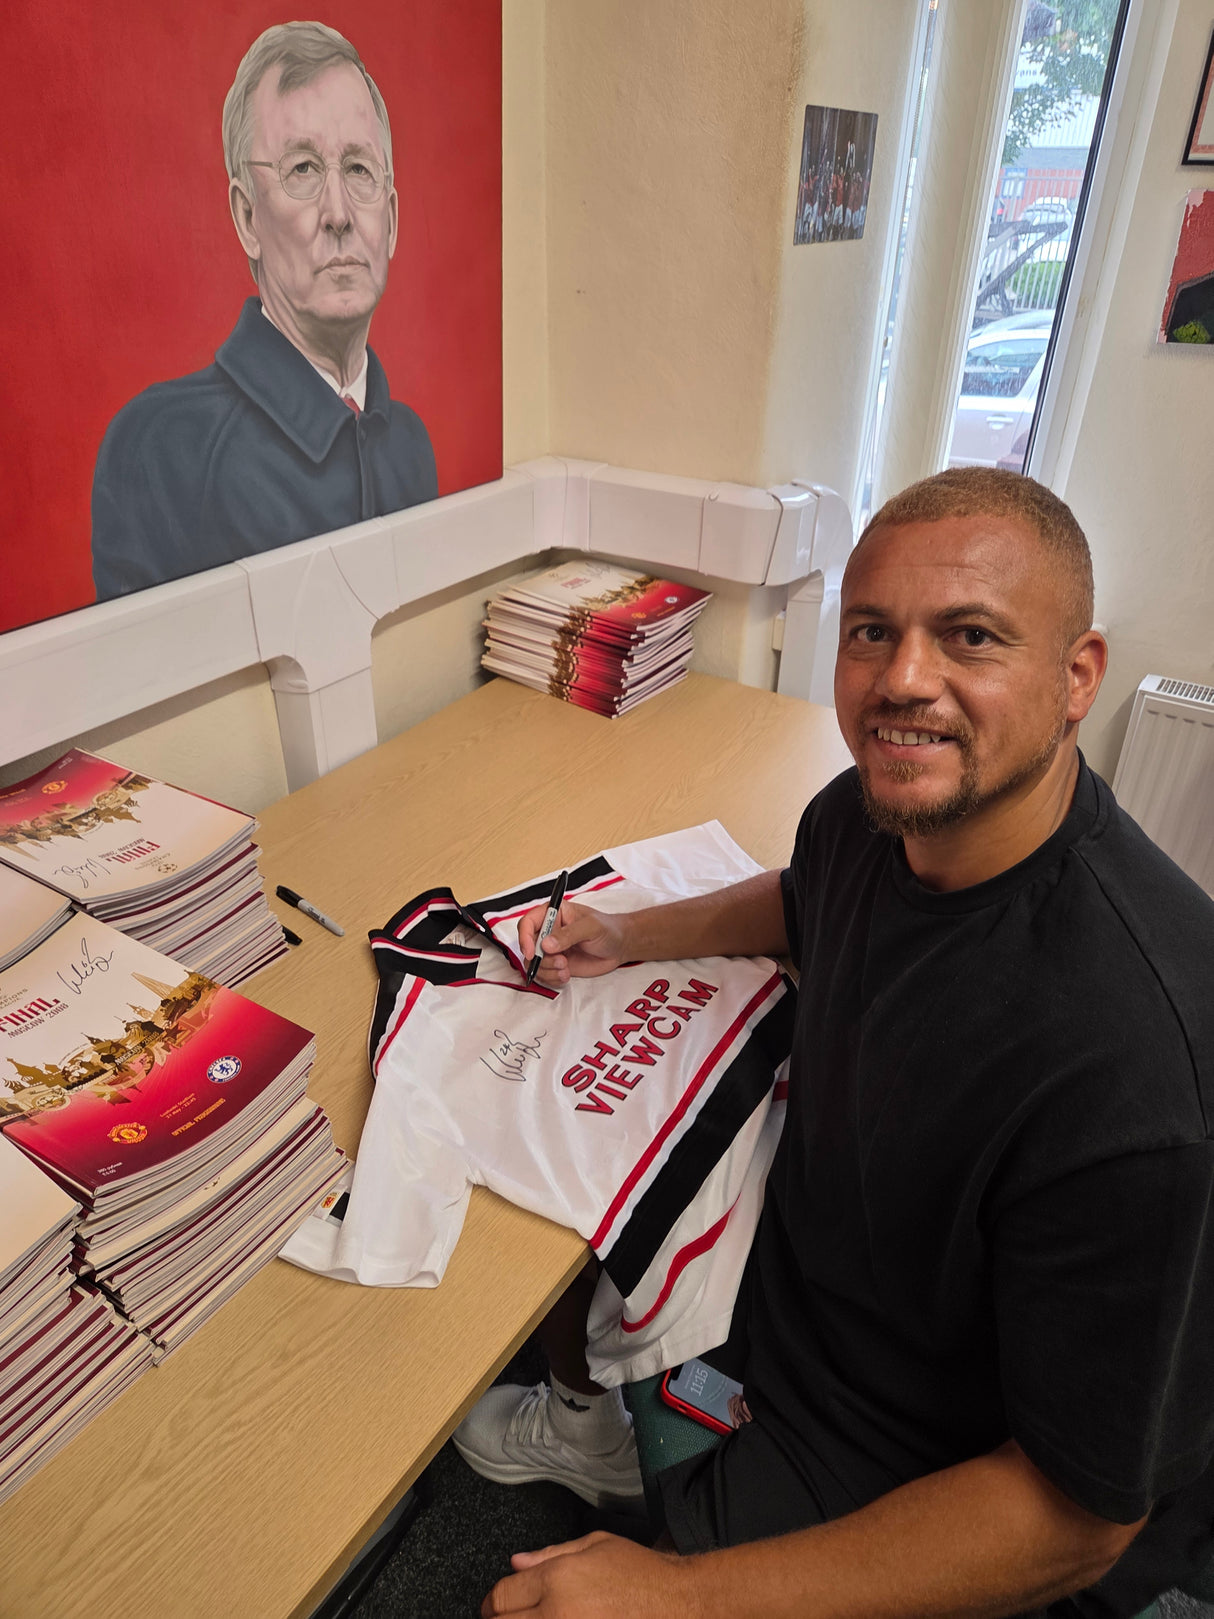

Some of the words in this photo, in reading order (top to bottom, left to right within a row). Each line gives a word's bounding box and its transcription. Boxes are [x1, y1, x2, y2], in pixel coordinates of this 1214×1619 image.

[8, 1016, 45, 1039] MOSCOW
[45, 1002, 69, 1019] 2008
[561, 978, 671, 1094] SHARP
[575, 977, 720, 1116] VIEWCAM
[690, 1367, 709, 1397] 11:15
